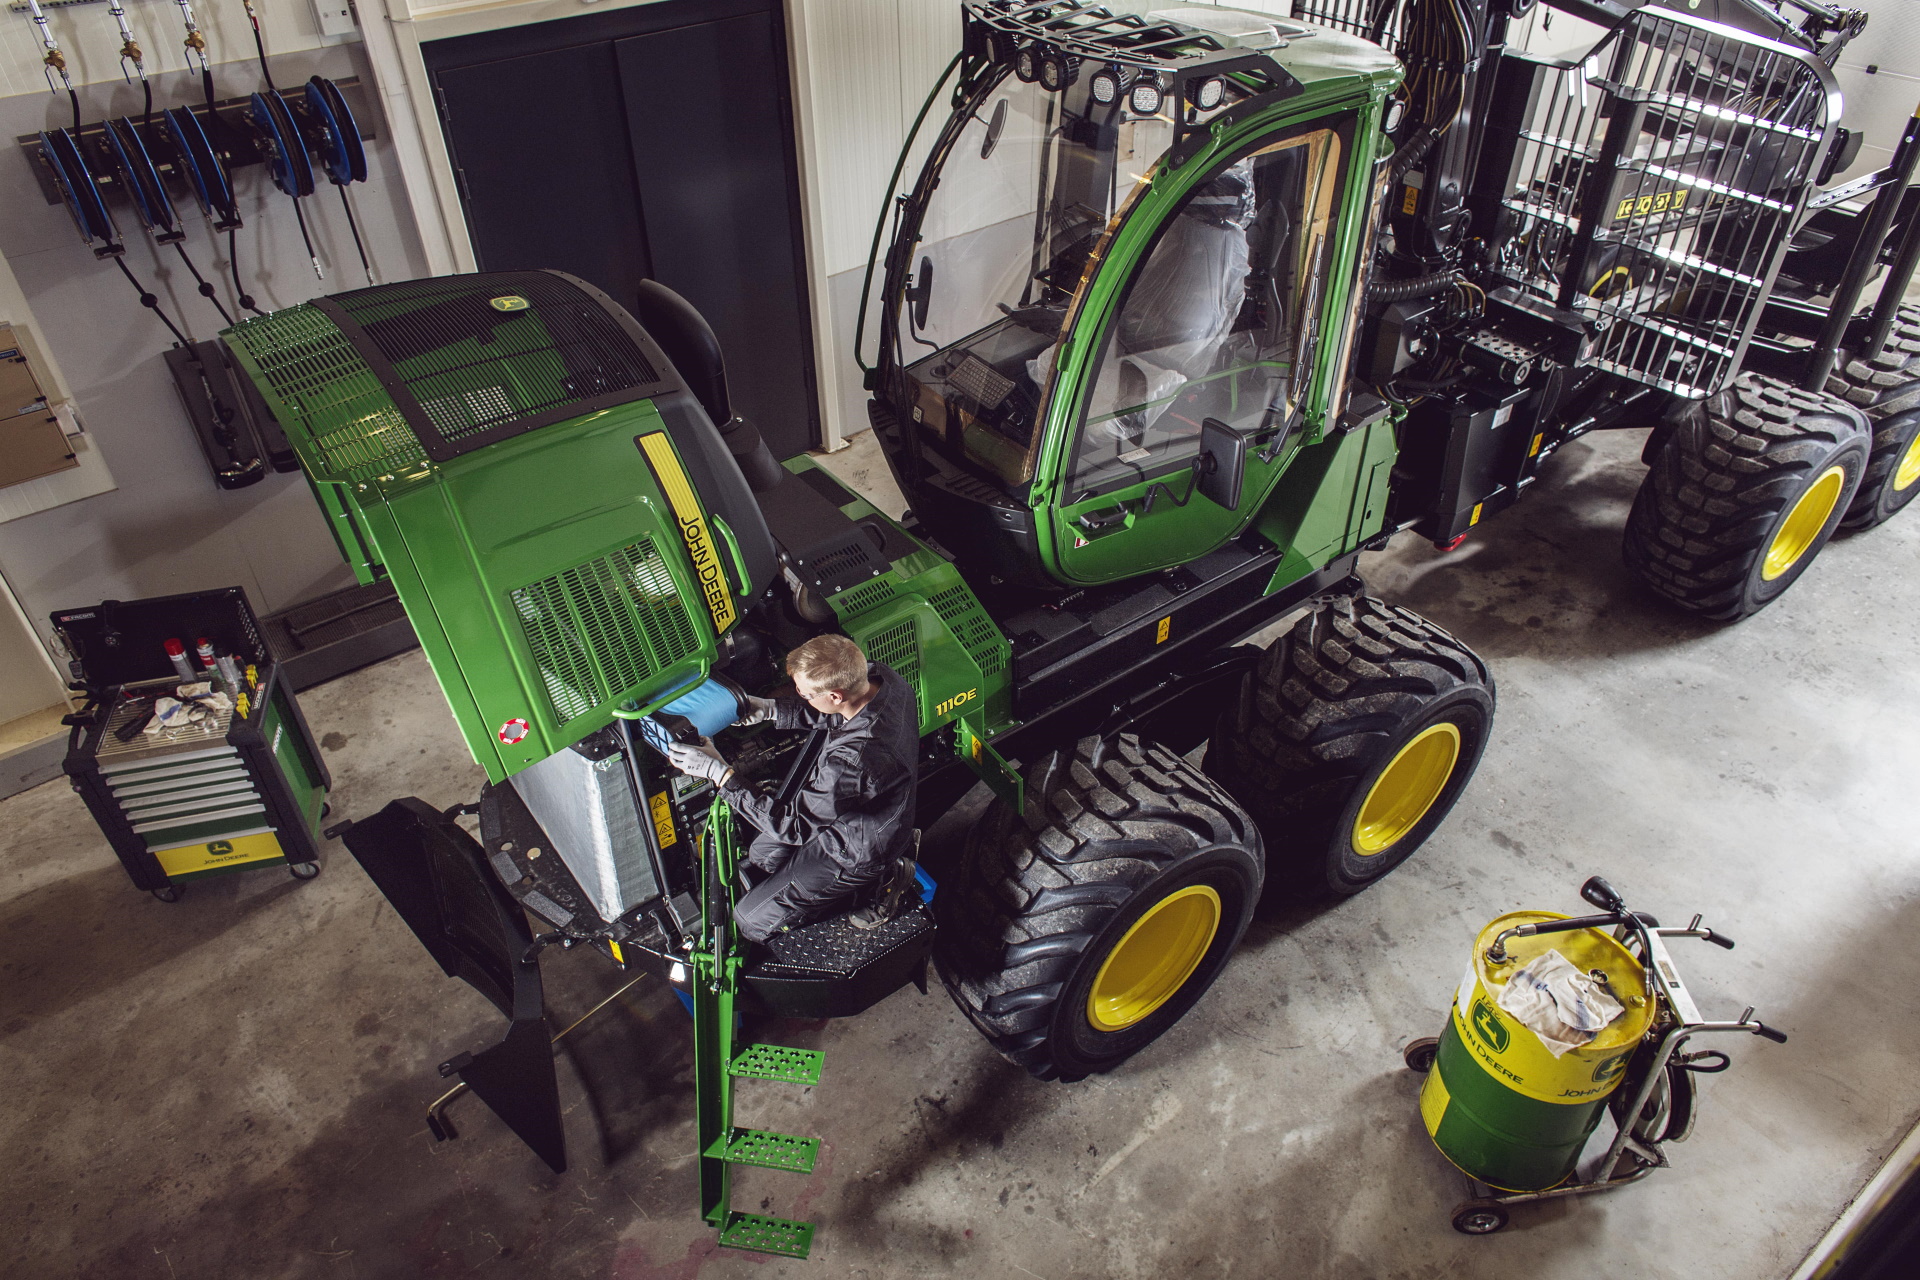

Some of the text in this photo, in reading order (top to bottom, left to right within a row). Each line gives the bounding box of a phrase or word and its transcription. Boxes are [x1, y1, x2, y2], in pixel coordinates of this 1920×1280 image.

[681, 517, 730, 623] JOHN DEERE
[935, 687, 977, 717] 1110E
[224, 853, 249, 861] DEERE
[1476, 1044, 1524, 1084] DEERE
[1557, 1087, 1602, 1097] JOHN
